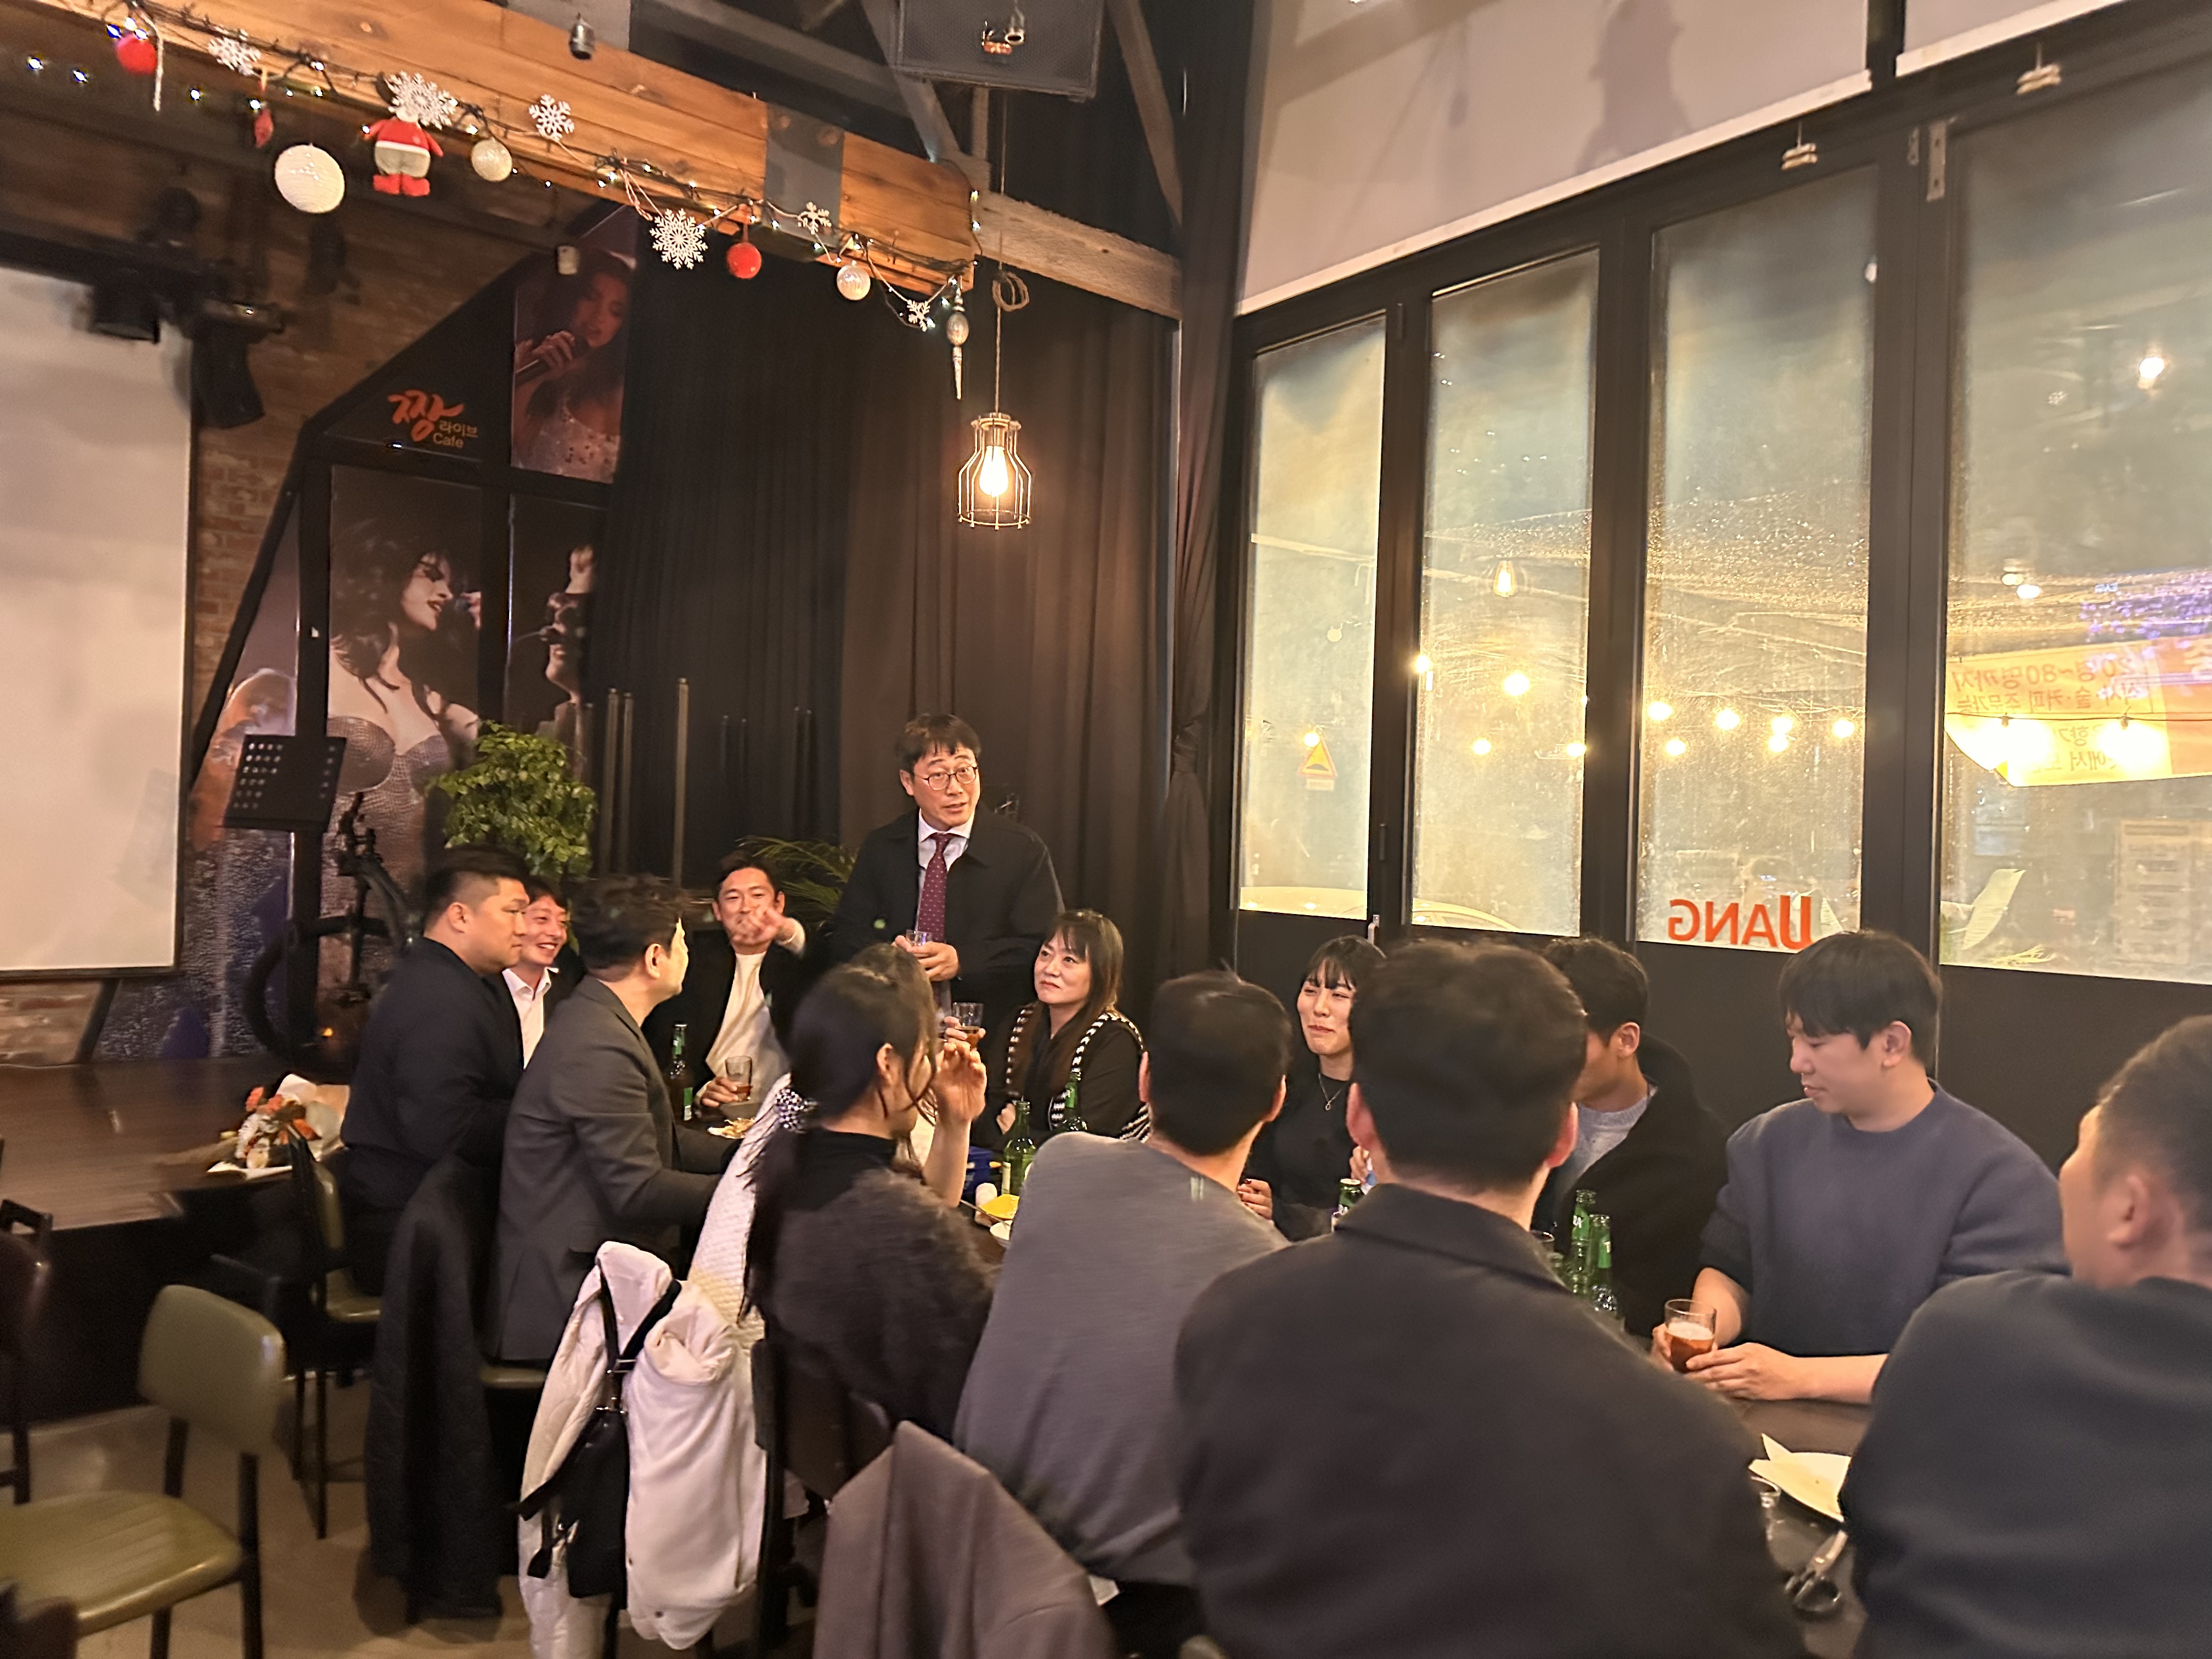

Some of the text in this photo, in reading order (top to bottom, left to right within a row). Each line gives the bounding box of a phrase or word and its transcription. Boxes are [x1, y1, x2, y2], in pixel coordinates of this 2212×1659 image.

[387, 390, 465, 442] 짱
[439, 420, 478, 438] 라이브
[433, 433, 464, 448] Cafe
